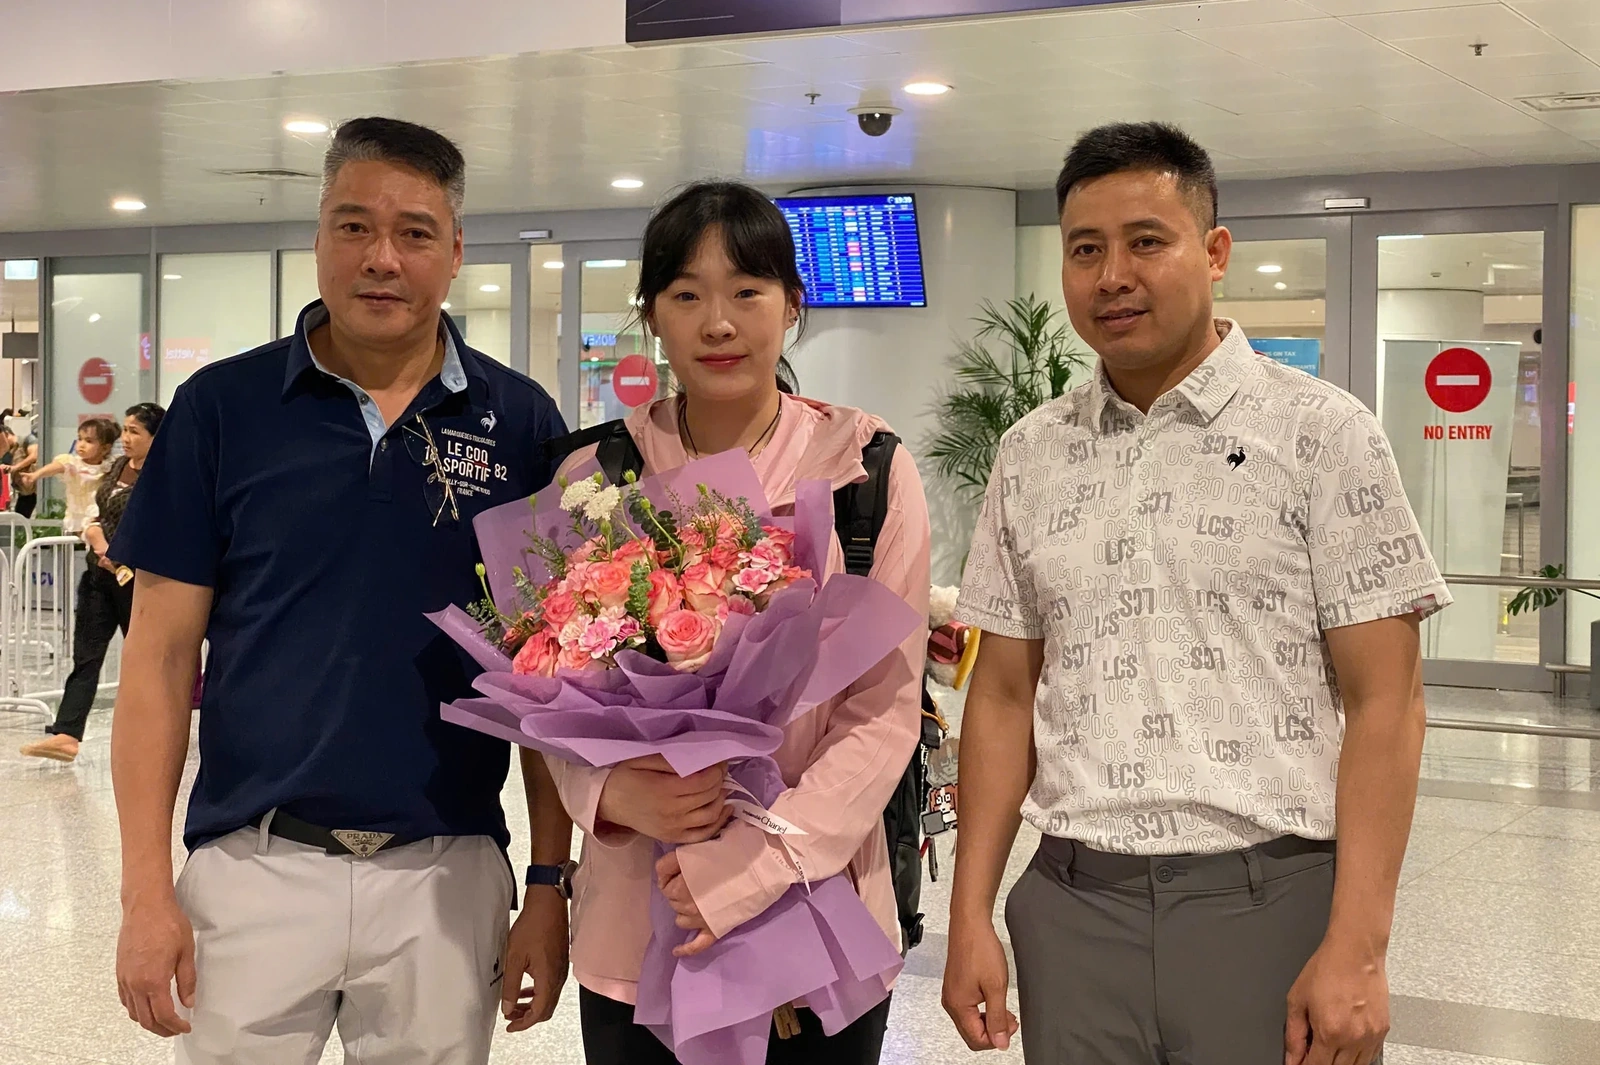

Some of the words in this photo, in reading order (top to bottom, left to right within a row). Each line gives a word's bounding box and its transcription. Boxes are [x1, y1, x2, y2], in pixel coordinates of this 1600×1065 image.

[1201, 435, 1238, 455] LCS
[1424, 425, 1443, 440] NO
[1448, 425, 1493, 440] ENTRY
[447, 440, 463, 457] LE
[465, 445, 489, 465] COQ
[1067, 439, 1098, 465] LCS
[1165, 444, 1194, 466] 30
[1320, 442, 1348, 472] 30
[443, 457, 491, 482] SPORTIF
[494, 463, 508, 481] 82
[1140, 461, 1161, 480] 30
[1340, 466, 1362, 490] 30
[1199, 478, 1224, 500] 30
[1345, 483, 1385, 517] LCS
[1047, 507, 1081, 536] LCS
[1105, 519, 1127, 541] 30
[1196, 514, 1234, 538] LCS
[1105, 536, 1136, 565] LCS
[1275, 551, 1298, 575] 30
[1378, 533, 1425, 568] LCS
[1047, 555, 1067, 582] 30
[1316, 563, 1345, 586] 30
[1346, 563, 1387, 595] LCS
[1120, 588, 1155, 617] LCS
[1253, 589, 1287, 613] LCS
[1062, 643, 1091, 669] LCS
[1191, 647, 1226, 670] LCS
[1276, 641, 1307, 667] LCS
[1103, 655, 1138, 681] LCS
[1157, 657, 1184, 682] 30
[1106, 680, 1133, 705] 30
[1188, 677, 1211, 699] 30
[1196, 697, 1223, 723] 30
[1142, 714, 1175, 739] LCS
[1274, 715, 1315, 742] LCS
[1104, 741, 1127, 762] 30
[1205, 740, 1241, 762] LCS
[1107, 762, 1146, 789] LCS
[1257, 777, 1282, 798] 30
[760, 815, 788, 835] Chanel
[1134, 811, 1179, 840] LCS
